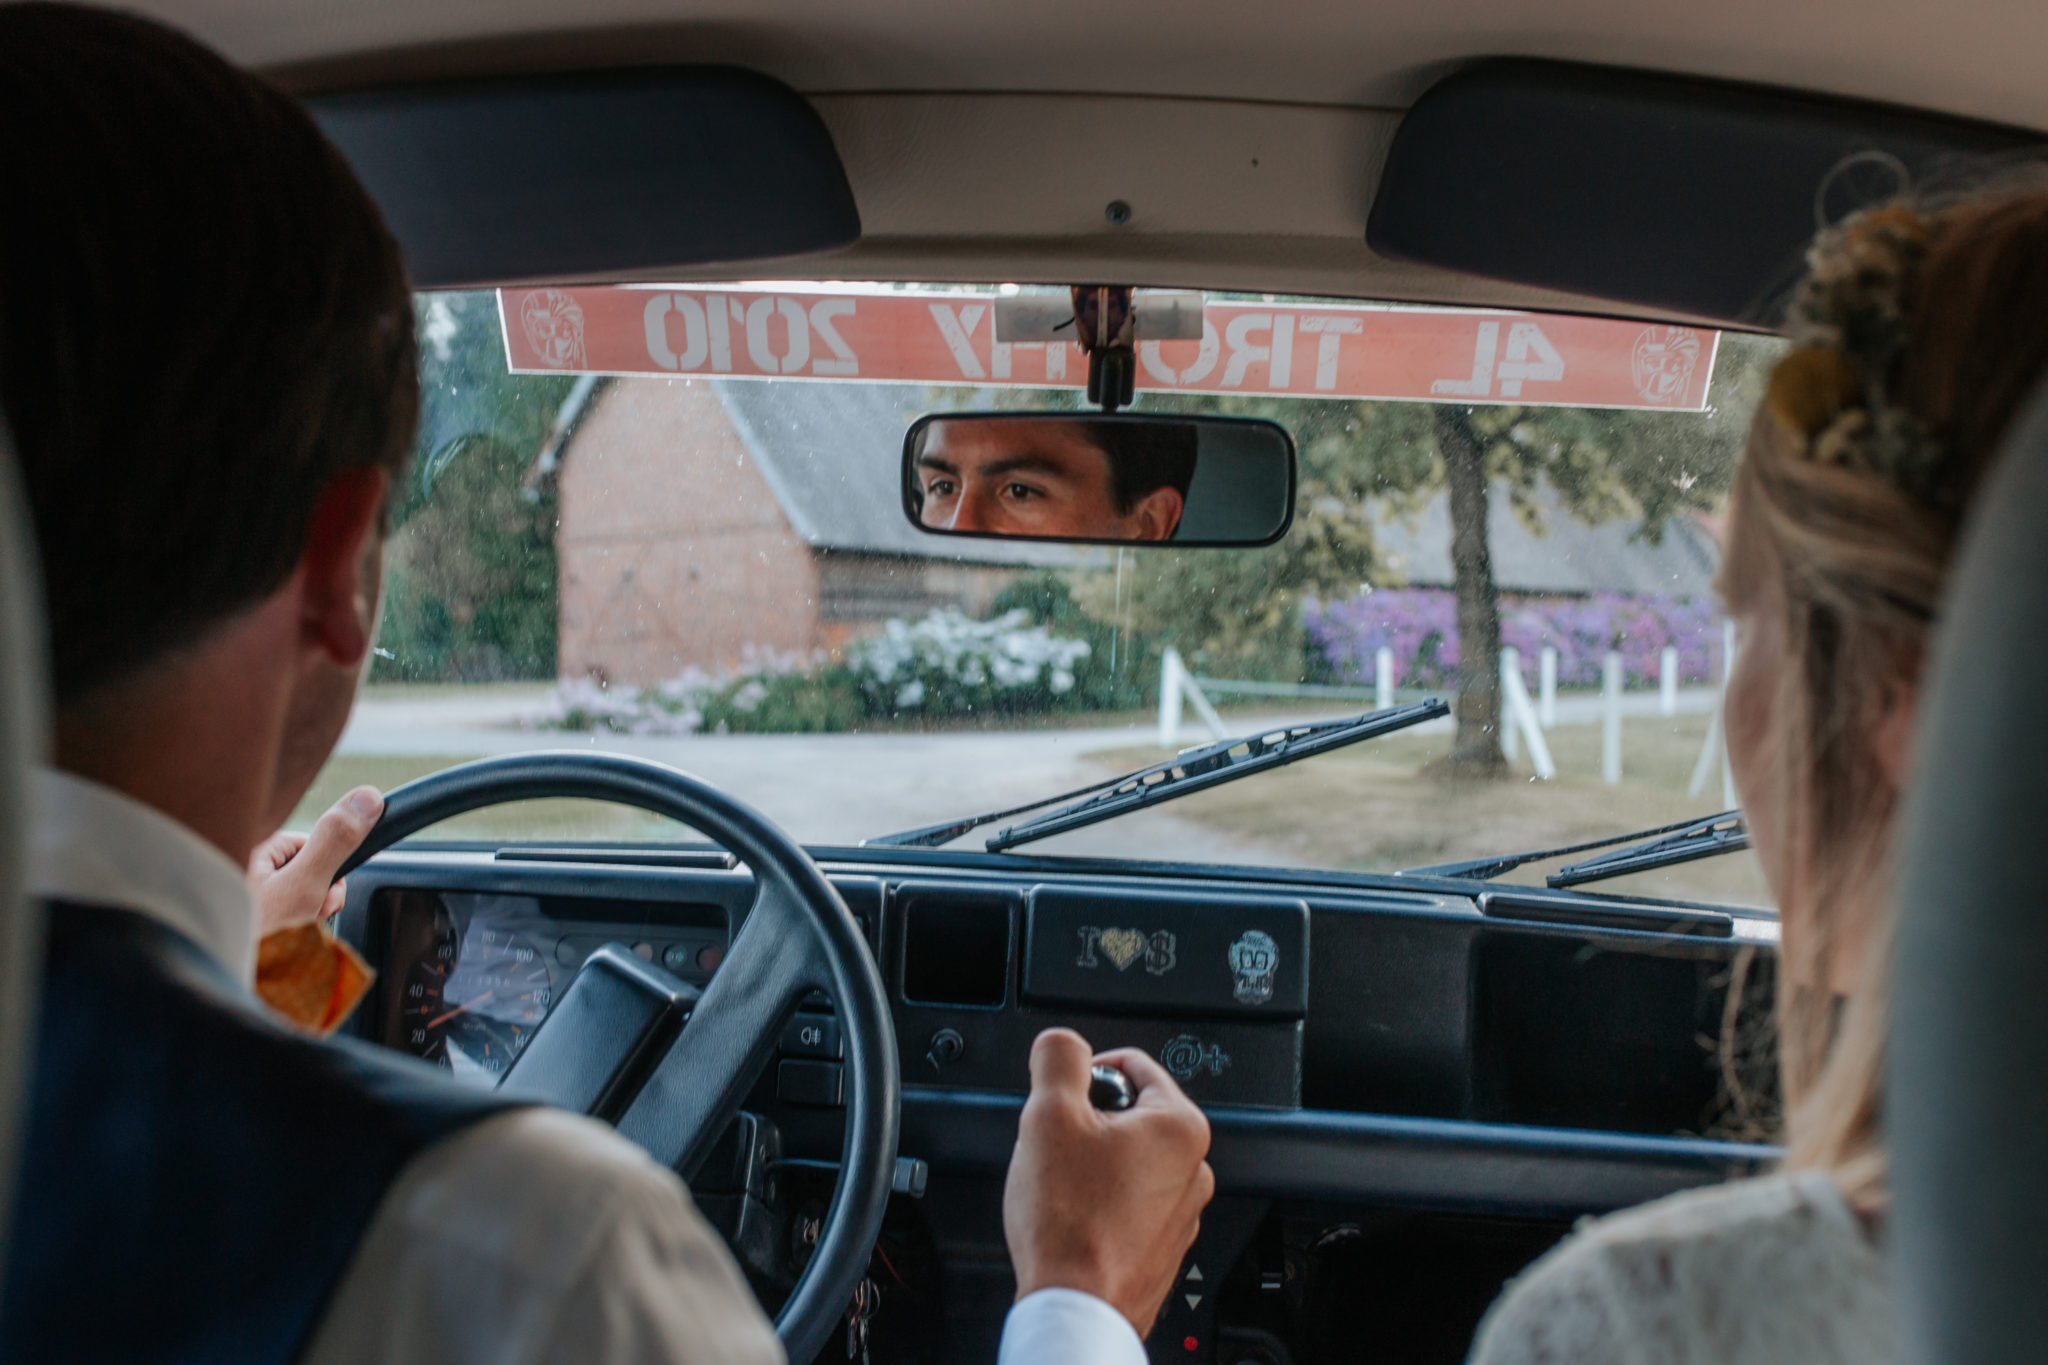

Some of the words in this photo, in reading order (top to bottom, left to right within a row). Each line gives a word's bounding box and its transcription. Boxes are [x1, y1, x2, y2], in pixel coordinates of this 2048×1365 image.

[438, 946, 452, 958] 60
[516, 949, 534, 962] 100
[408, 983, 424, 998] 40
[532, 989, 551, 1003] 120
[411, 1029, 426, 1043] 20
